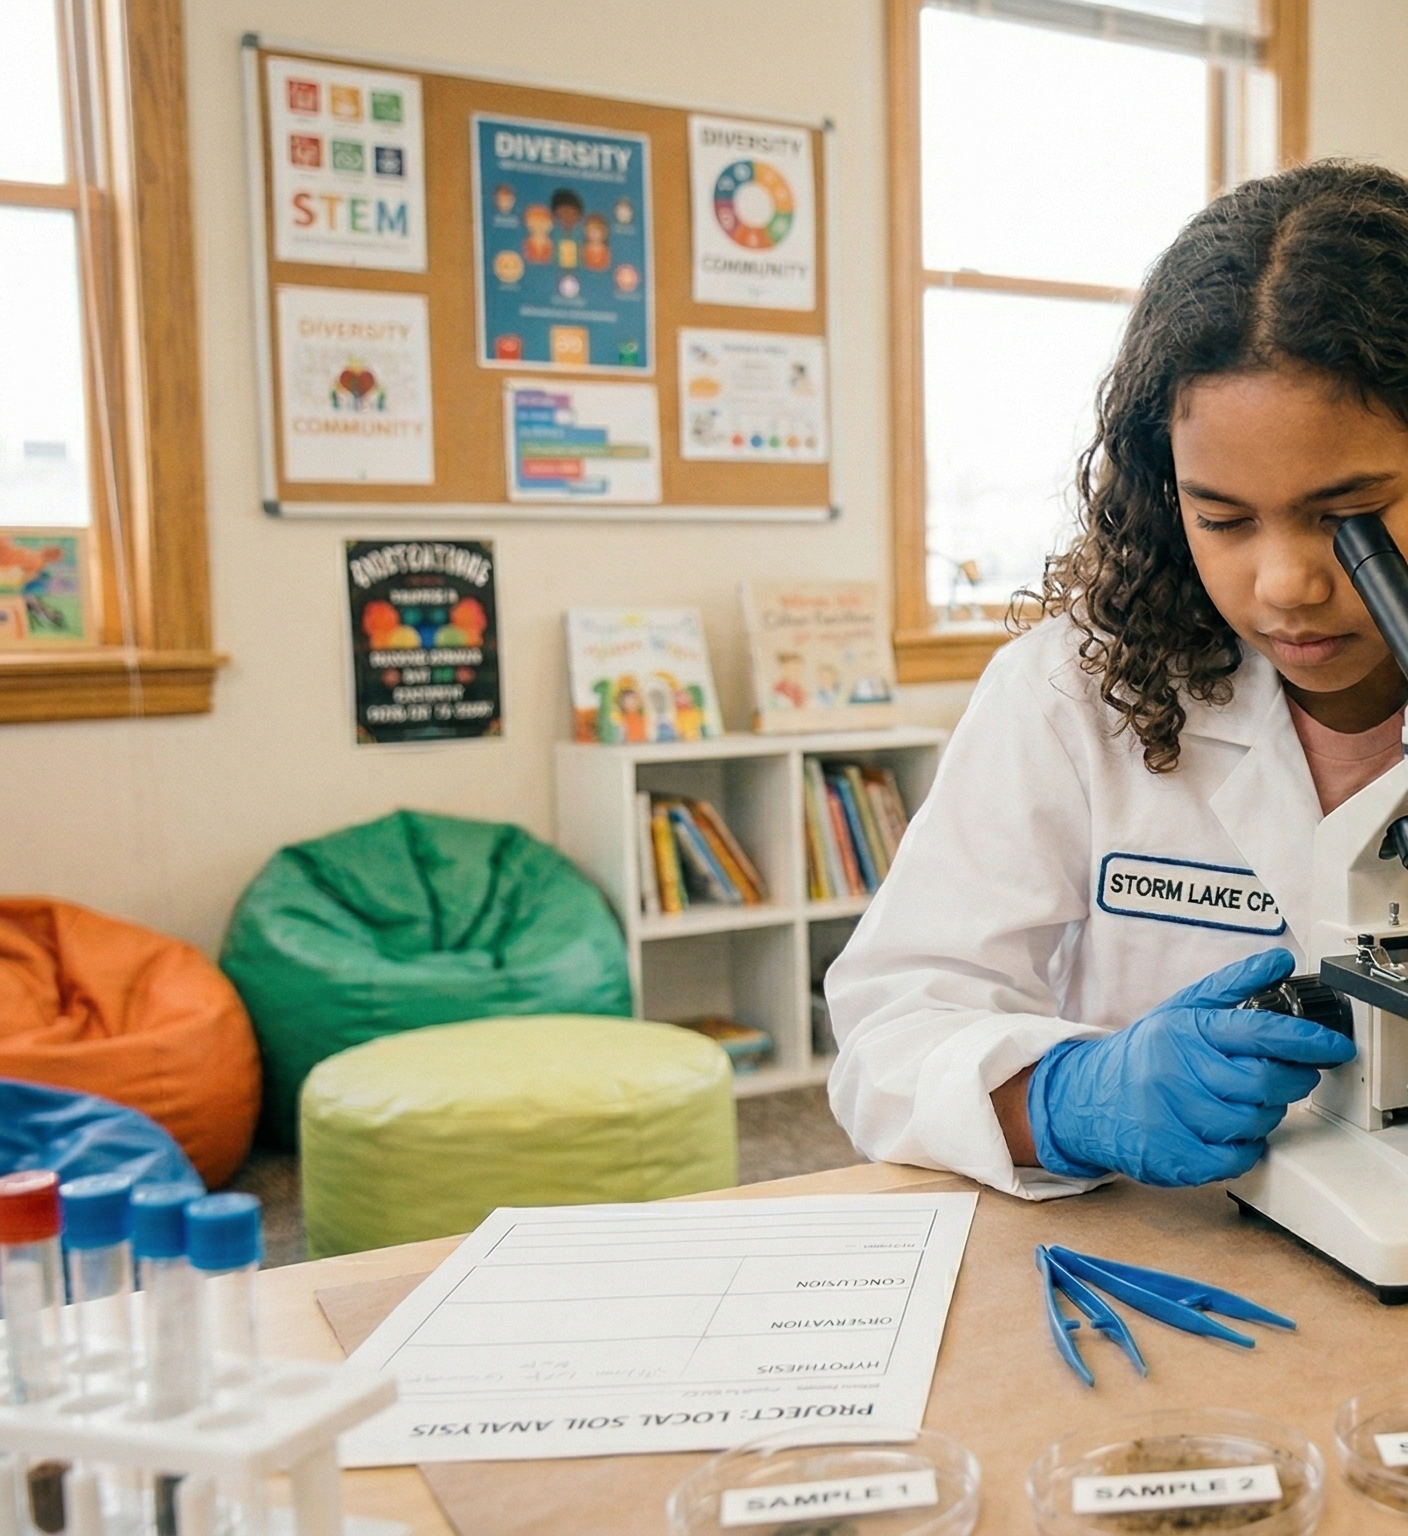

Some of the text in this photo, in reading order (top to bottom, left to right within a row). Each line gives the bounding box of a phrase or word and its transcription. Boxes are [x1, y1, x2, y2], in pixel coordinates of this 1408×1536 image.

[494, 131, 632, 173] DIVERSITY
[702, 128, 803, 153] DIVERSITY
[292, 192, 409, 237] STEM
[702, 256, 809, 279] COMMUNITY
[299, 317, 412, 341] DIVERSITY
[293, 417, 424, 439] COMMUNITY
[1110, 873, 1279, 914] STORM LAKE CP
[408, 1403, 874, 1437] PROJECT: LOCAL SOIL ANALYSIS
[747, 1483, 908, 1511] SAMPLE 1
[1095, 1477, 1254, 1499] SAMPLE 2
